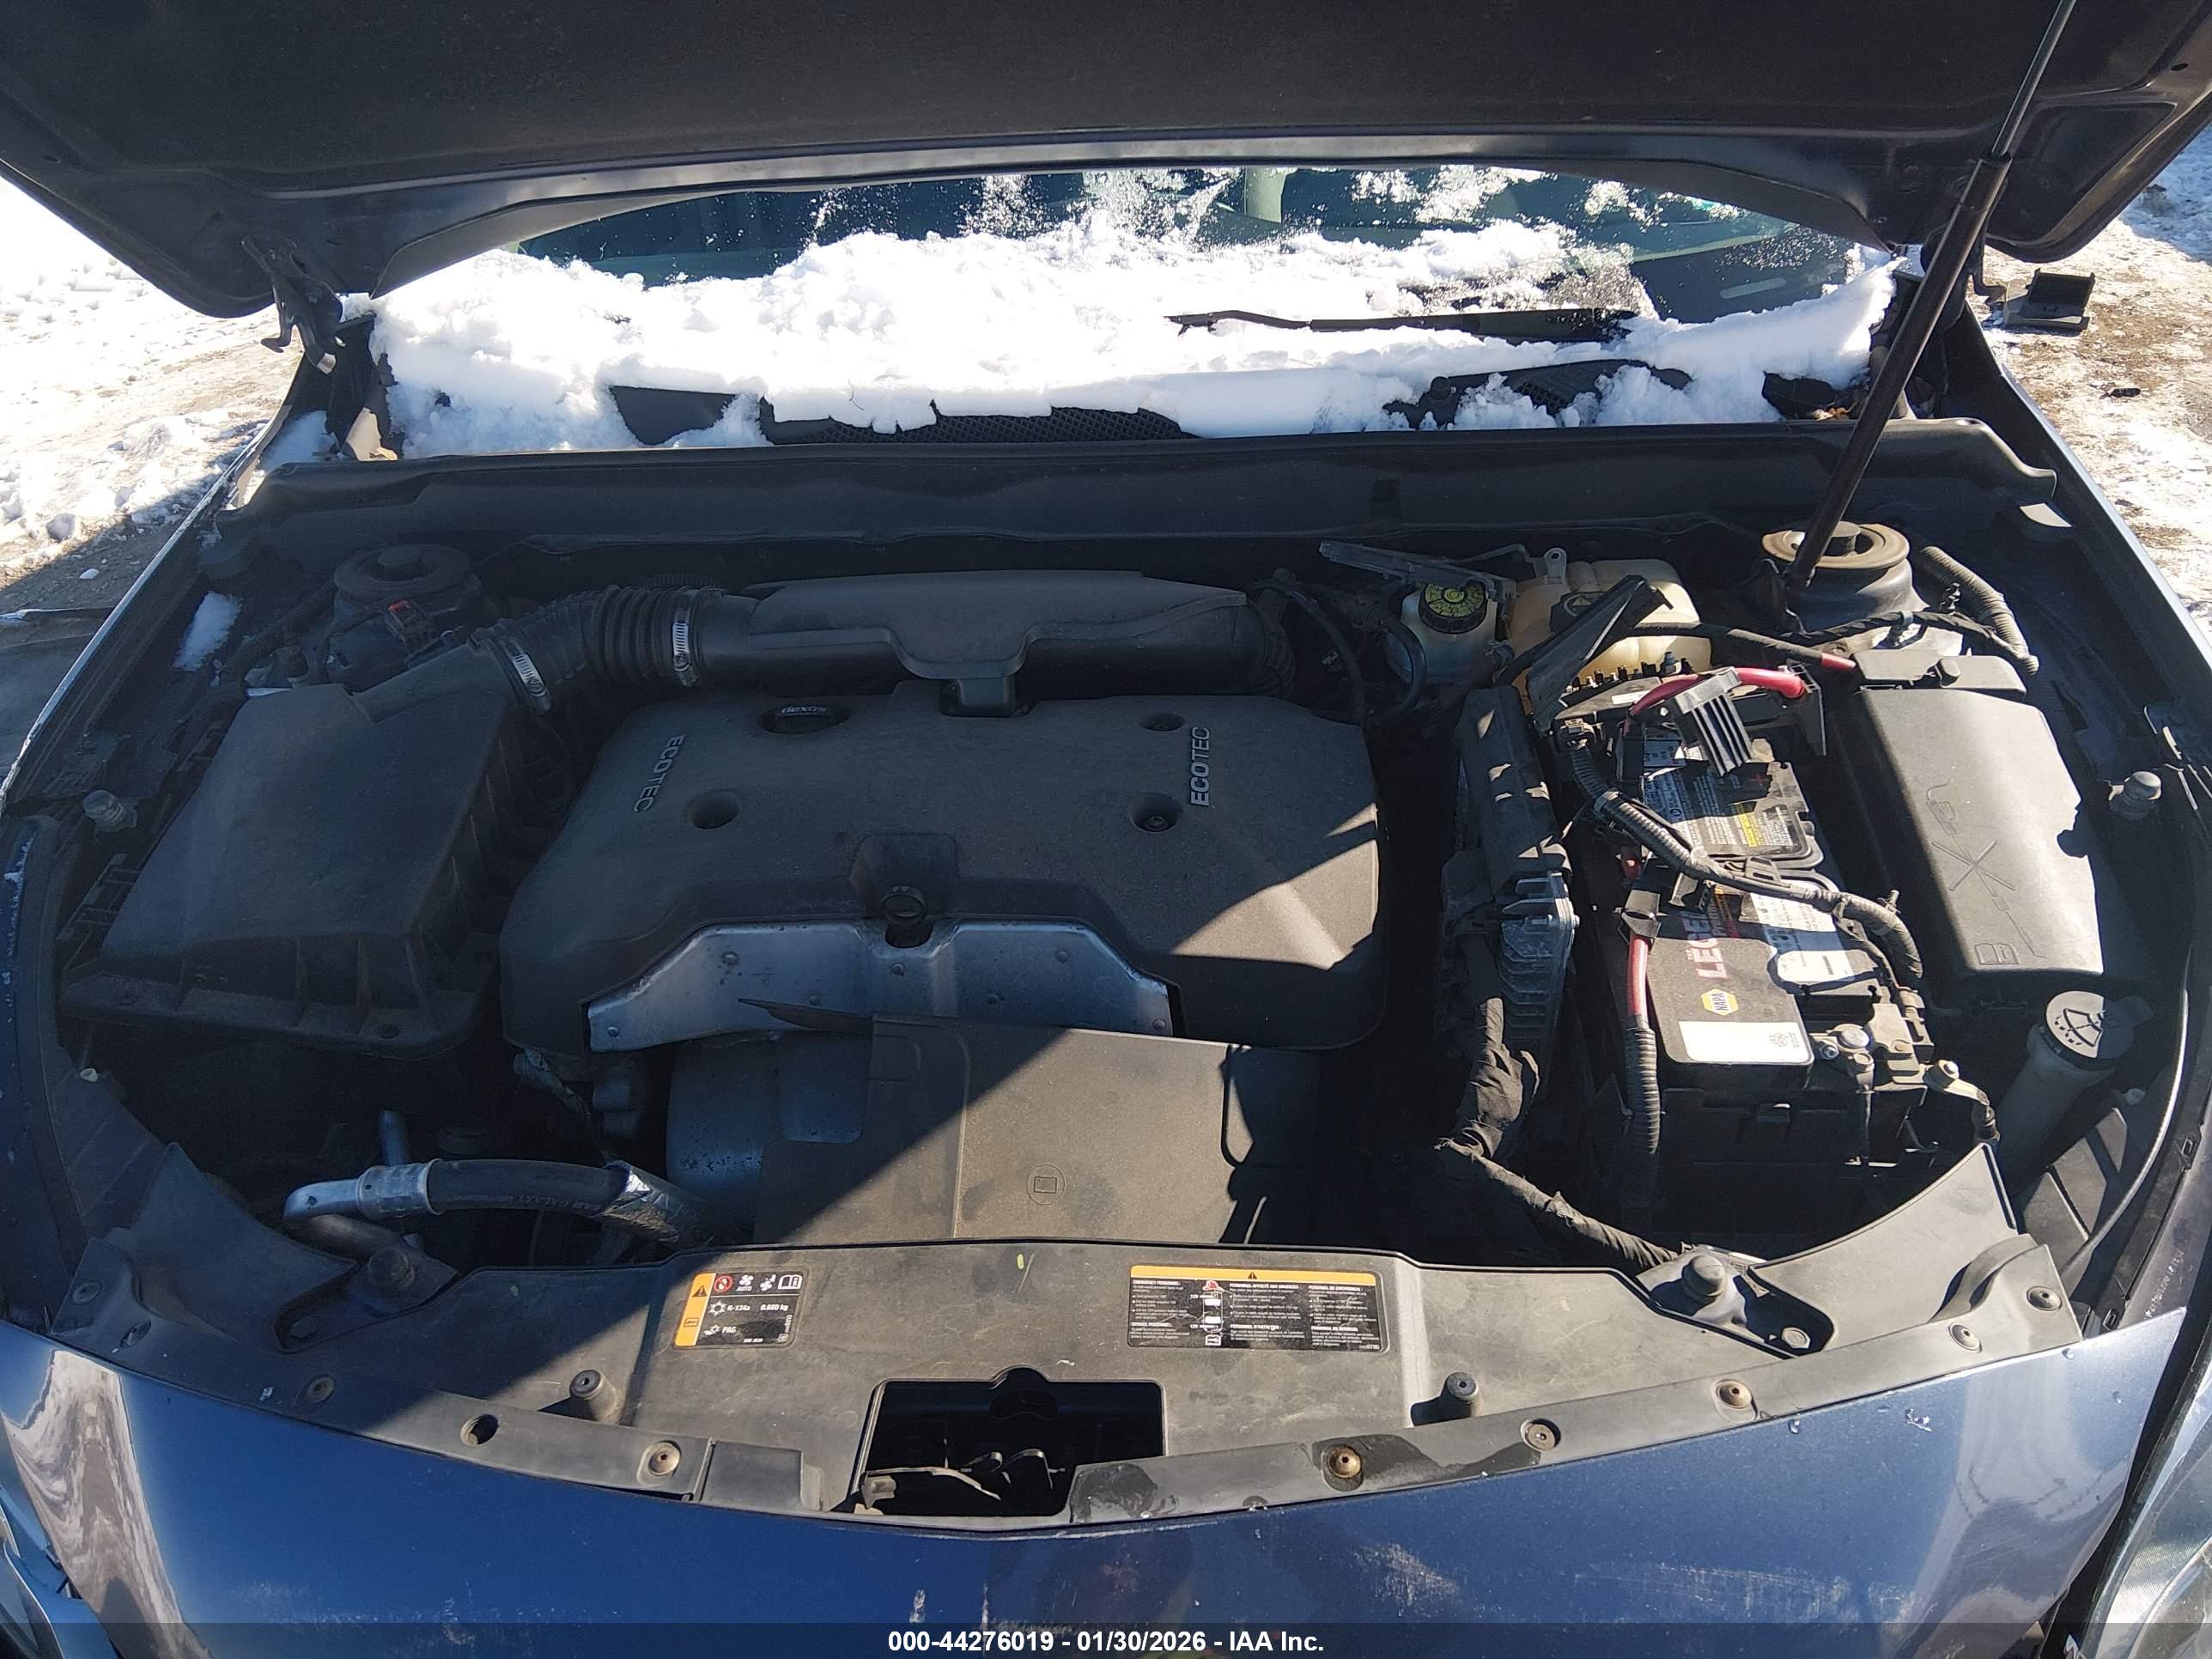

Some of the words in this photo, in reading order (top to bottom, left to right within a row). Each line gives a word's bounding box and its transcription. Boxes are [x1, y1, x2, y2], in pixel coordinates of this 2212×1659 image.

[634, 734, 685, 812] ECOTEC
[1190, 726, 1210, 807] ECOTEC
[1711, 993, 1729, 1011] NAPA
